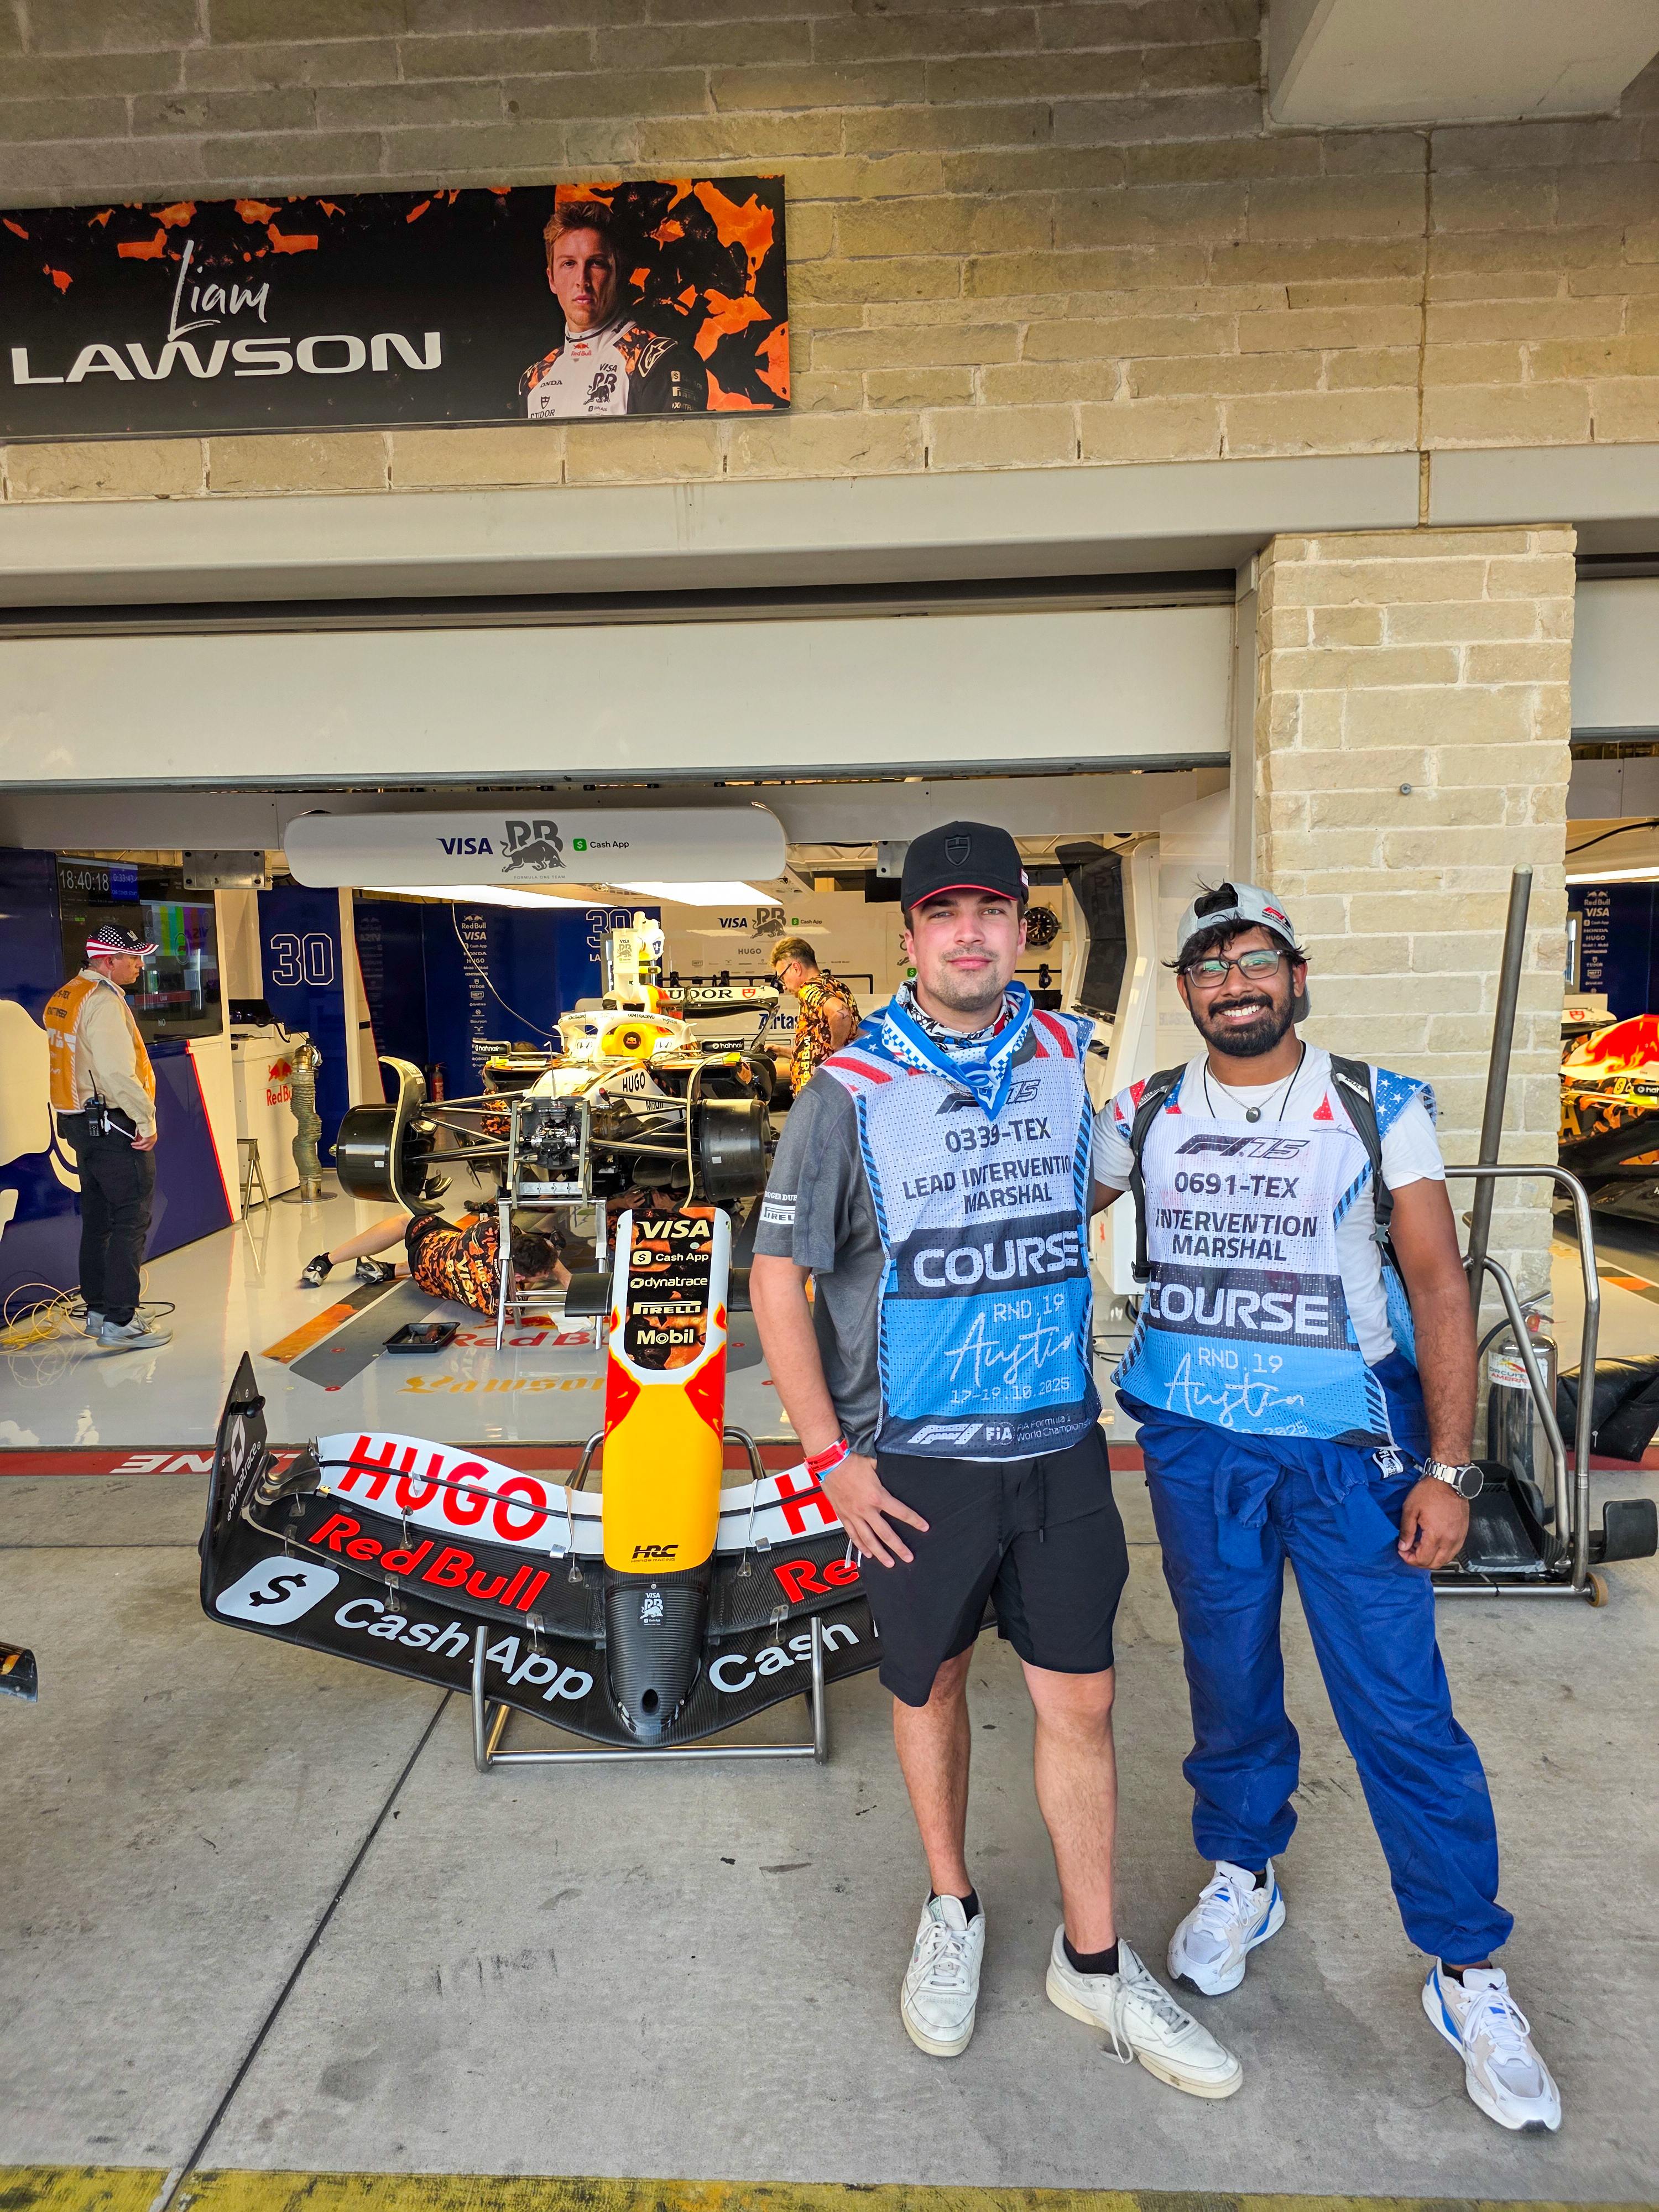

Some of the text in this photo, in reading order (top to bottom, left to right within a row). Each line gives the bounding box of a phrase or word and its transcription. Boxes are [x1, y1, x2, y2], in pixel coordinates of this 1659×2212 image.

[168, 239, 269, 341] Liam
[11, 332, 442, 384] LAWSON
[599, 363, 618, 372] VISA
[540, 379, 563, 388] ONDA
[436, 837, 493, 855] VISA
[612, 841, 629, 849] App
[60, 869, 109, 891] 18:40:18
[717, 917, 748, 928] VISA
[1584, 907, 1610, 917] VISA
[462, 931, 487, 940] VISA
[586, 909, 632, 948] 30
[270, 933, 334, 986] 30
[667, 989, 733, 999] UDOR
[266, 1084, 293, 1106] Red Bu
[623, 1071, 645, 1093] HUGO
[1345, 1078, 1365, 1093] MULE
[945, 1117, 1051, 1153] 0339-TEX
[902, 1154, 1072, 1200] LEAD INTERVENTIO
[1174, 1171, 1300, 1199] 0691-TEX
[764, 1191, 781, 1201] ROGER
[964, 1183, 1052, 1214] MARSHAL
[764, 1206, 795, 1221] PIREL
[1156, 1208, 1317, 1238] INTERVENTION
[636, 1219, 711, 1239] VISA
[655, 1253, 684, 1261] Cash
[685, 1253, 709, 1262] App
[912, 1231, 1079, 1287] COURSE
[1172, 1234, 1288, 1262] MARSHAL
[456, 1254, 477, 1305] VISA
[475, 1259, 489, 1289] HUGO
[644, 1276, 708, 1288] dynatrace
[633, 1300, 702, 1315] PIRELLI
[1149, 1281, 1329, 1336] COURSE
[442, 1331, 550, 1348] Red
[637, 1329, 694, 1345] Mobil
[945, 1311, 1075, 1387] Austin
[1489, 1366, 1526, 1379] CIRCUIT
[1491, 1373, 1529, 1384] AMERIC
[1164, 1353, 1306, 1428] Austin
[907, 1423, 983, 1446] F1
[1017, 1423, 1030, 1432] FIA
[1030, 1415, 1066, 1428] Formula
[1066, 1413, 1071, 1422] 1
[1017, 1418, 1091, 1442] World Champions
[229, 1442, 258, 1511] dynatrace
[338, 1434, 549, 1543] HUGO
[307, 1512, 551, 1612] Red Bull
[632, 1545, 679, 1559] HRC
[773, 1559, 860, 1603] Re
[333, 1597, 465, 1658] Cash
[468, 1637, 594, 1702] App
[708, 1623, 860, 1693] Cash
